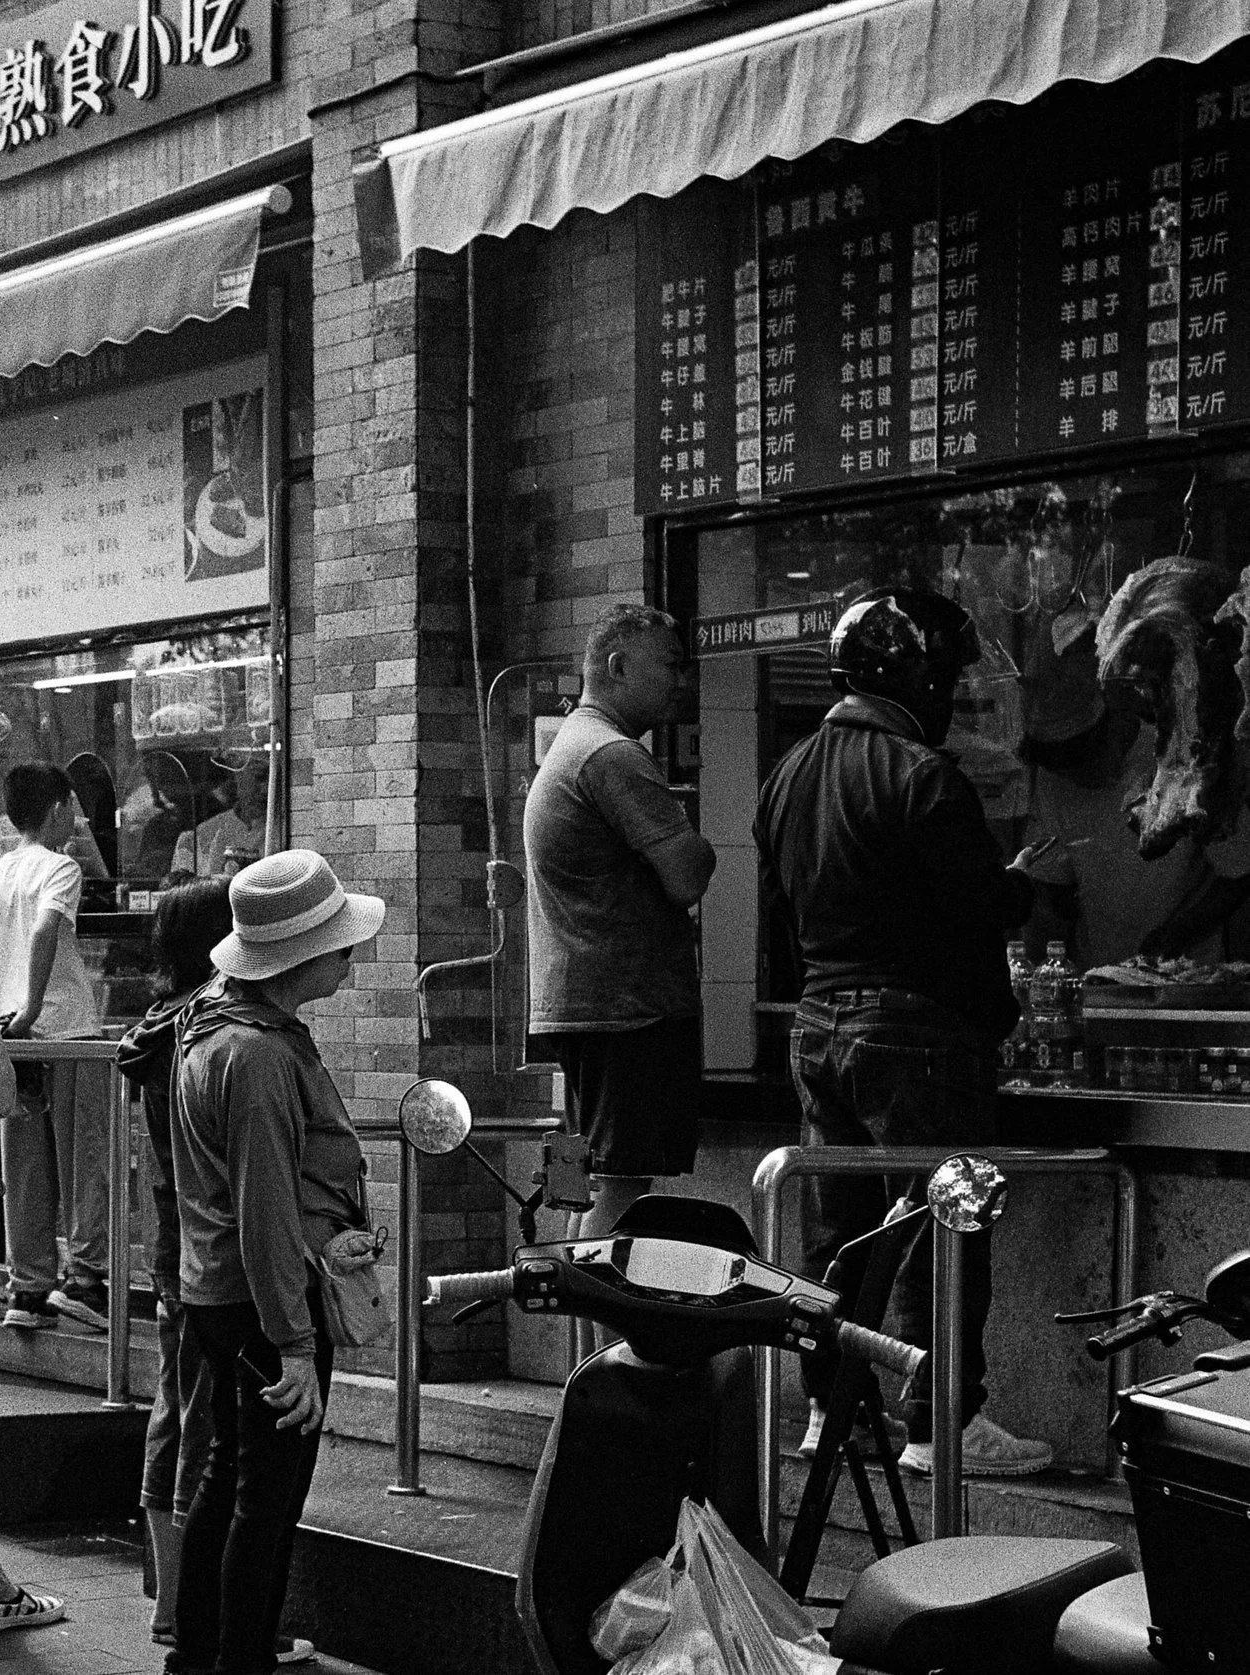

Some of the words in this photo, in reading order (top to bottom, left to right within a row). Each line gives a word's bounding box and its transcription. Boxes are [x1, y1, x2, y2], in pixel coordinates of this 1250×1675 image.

[1062, 178, 1122, 209] 羊肉片
[1062, 212, 1142, 248] 高钙肉片
[1190, 190, 1229, 220] 元/斤
[943, 242, 978, 269] 元/斤
[1061, 254, 1121, 286] 羊腰窝
[1189, 231, 1229, 260] 元/斤
[661, 278, 707, 303] 肥牛片
[766, 284, 796, 309] 元/斤
[943, 273, 978, 301] 元/斤
[1061, 292, 1120, 324] 羊腱子
[1188, 271, 1228, 300] 元/斤
[766, 313, 796, 338] 元/斤
[943, 305, 978, 332] 元/斤
[1060, 331, 1119, 362] 羊前腿
[1188, 311, 1227, 340] 元/斤
[766, 343, 796, 368] 元/斤
[943, 337, 978, 364] 元/斤
[766, 373, 796, 398] 元/斤
[943, 369, 978, 395] 元/斤
[1059, 370, 1119, 401] 羊后腿
[1187, 351, 1226, 380] 元/斤
[660, 419, 706, 445] 牛上脑
[766, 402, 796, 427] 元/斤
[840, 415, 892, 444] 牛百叶
[943, 400, 977, 426] 元/斤
[1059, 408, 1119, 439] 羊排
[1186, 391, 1225, 420] 元/斤
[660, 448, 706, 474] 牛里脊
[766, 432, 796, 457] 元/斤
[840, 446, 892, 474] 牛百叶
[943, 431, 977, 458] 元/盒
[660, 475, 722, 501] 牛上脑片
[766, 461, 796, 486] 元/斤
[695, 618, 753, 647] 今日鲜肉
[802, 609, 832, 634] 到店
